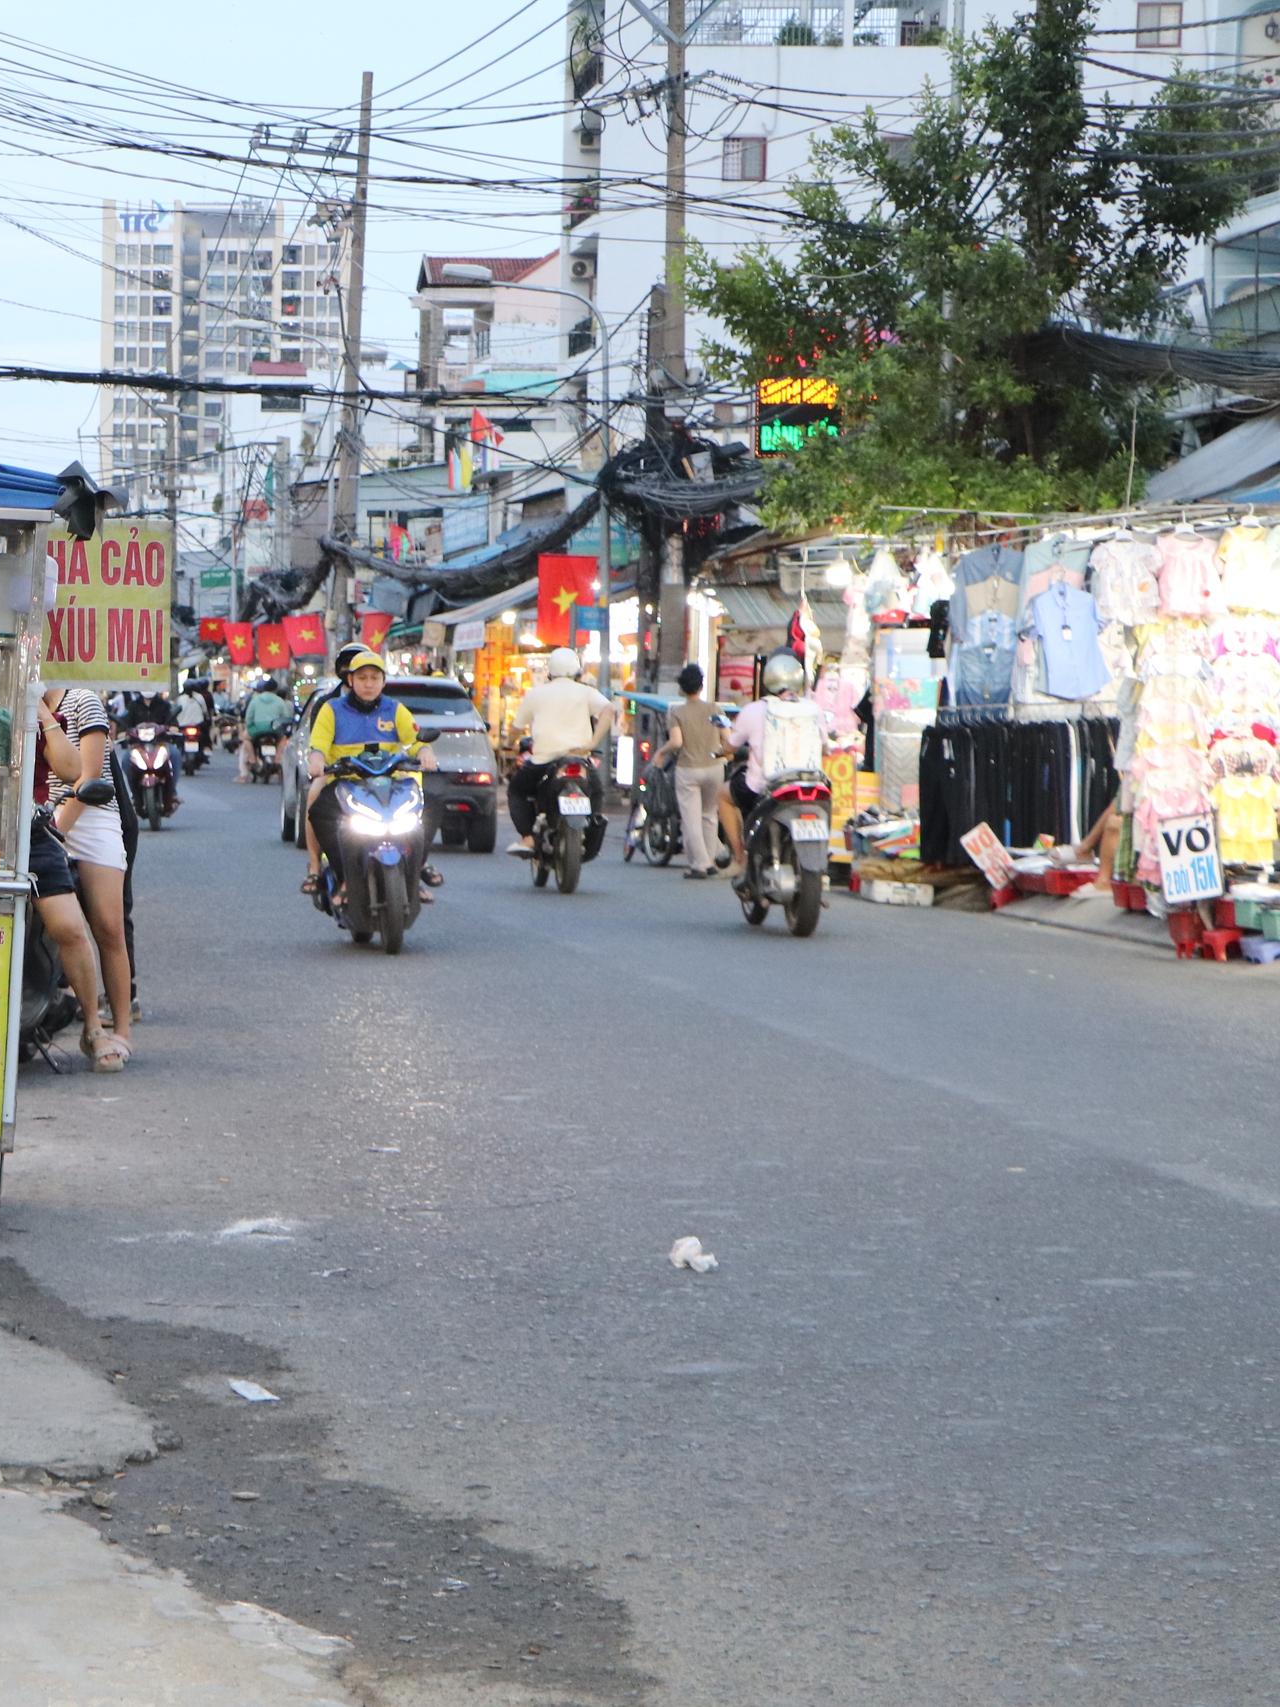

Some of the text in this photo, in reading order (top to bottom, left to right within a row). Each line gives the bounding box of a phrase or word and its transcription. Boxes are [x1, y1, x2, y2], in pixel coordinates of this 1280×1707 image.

[120, 213, 159, 233] TTC
[101, 526, 165, 587] CẢO
[46, 595, 163, 677] XÍU MẠI
[377, 717, 395, 732] be
[1162, 819, 1210, 856] VỚ
[1166, 871, 1174, 896] 2
[1190, 854, 1219, 891] 15K
